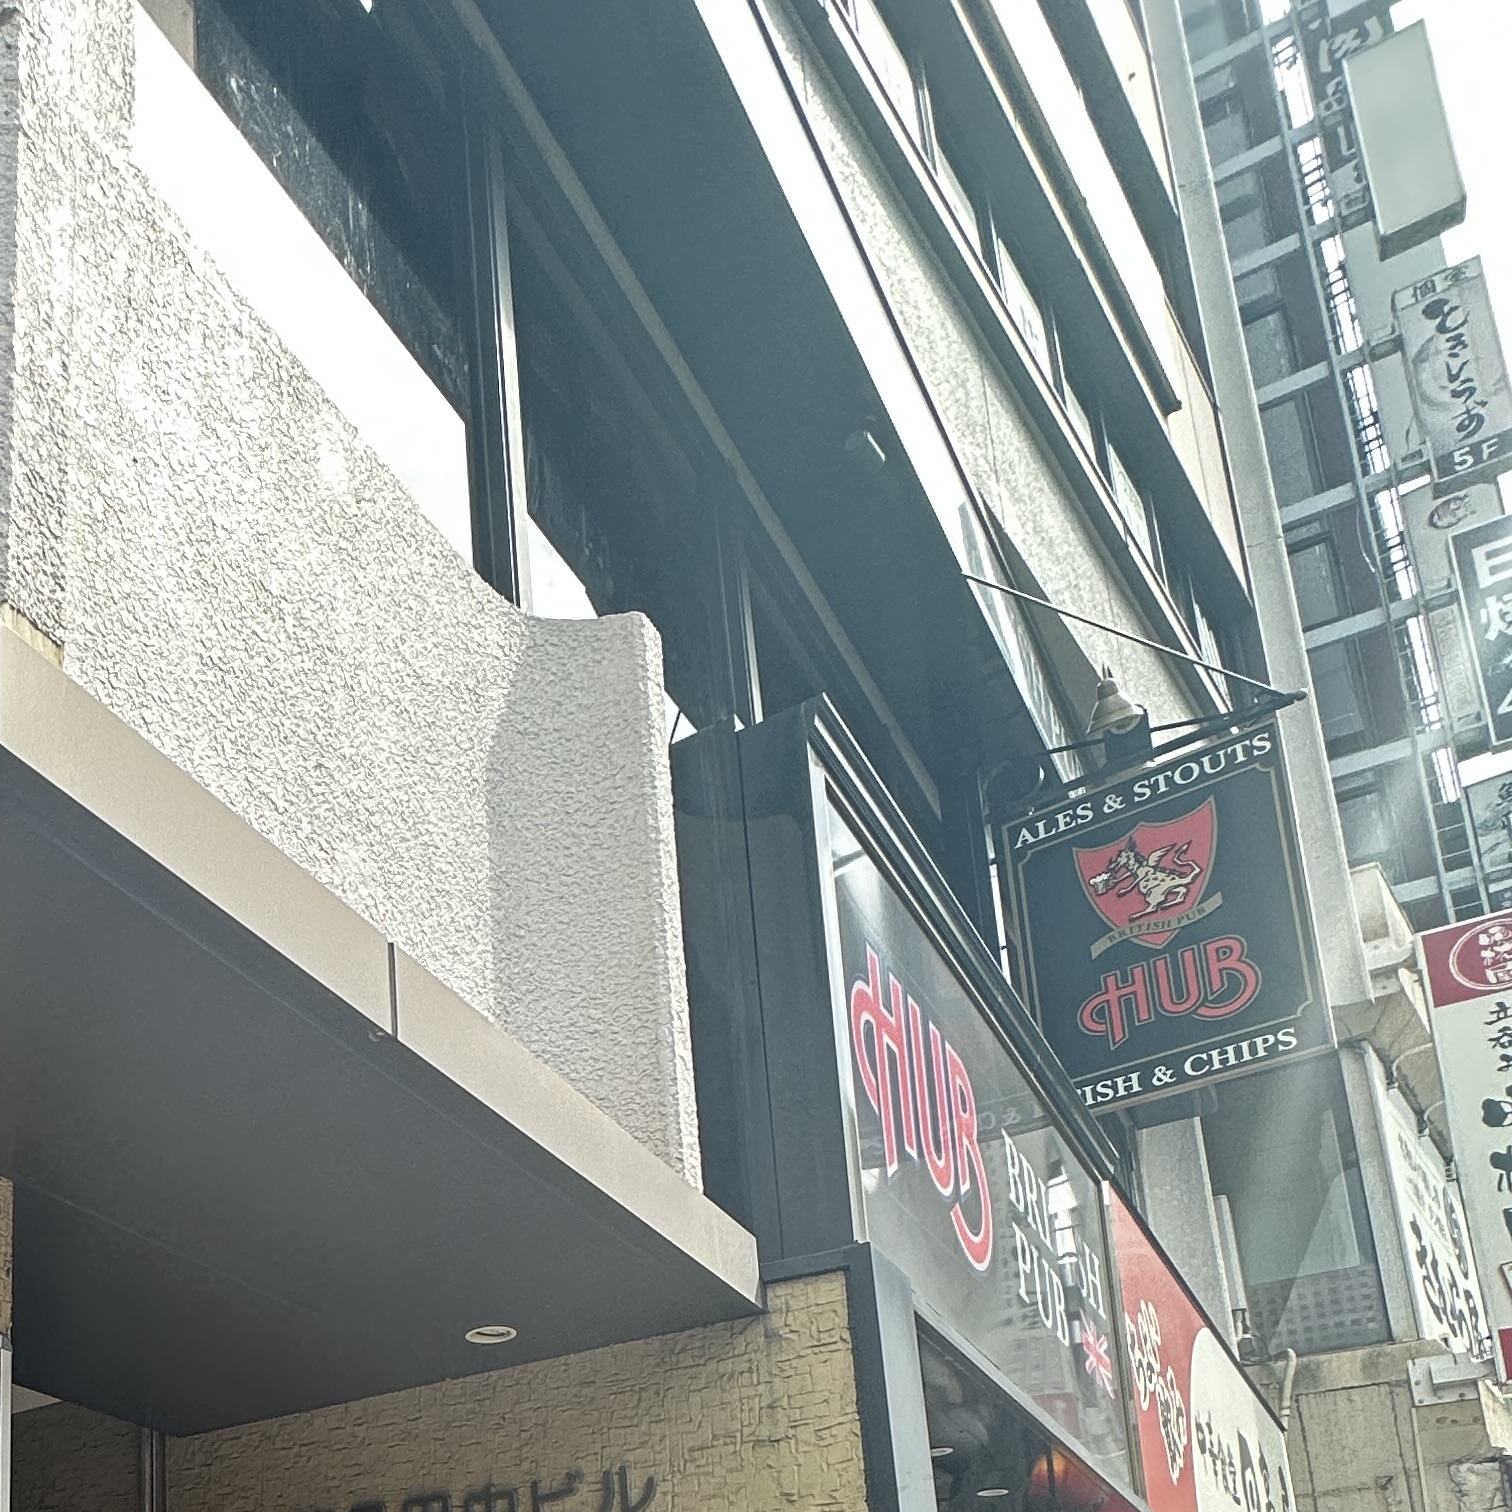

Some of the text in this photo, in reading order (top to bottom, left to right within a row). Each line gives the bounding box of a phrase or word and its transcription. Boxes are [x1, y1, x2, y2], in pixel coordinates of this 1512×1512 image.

[1014, 730, 1273, 850] ALES & STOUTS
[1107, 905, 1207, 944] BRITISH PUB
[1076, 933, 1262, 1052] HUB
[850, 941, 994, 1274] HUB
[1150, 1064, 1177, 1090] &
[1183, 1026, 1298, 1078] CHIPS
[1011, 1220, 1070, 1348] PUB
